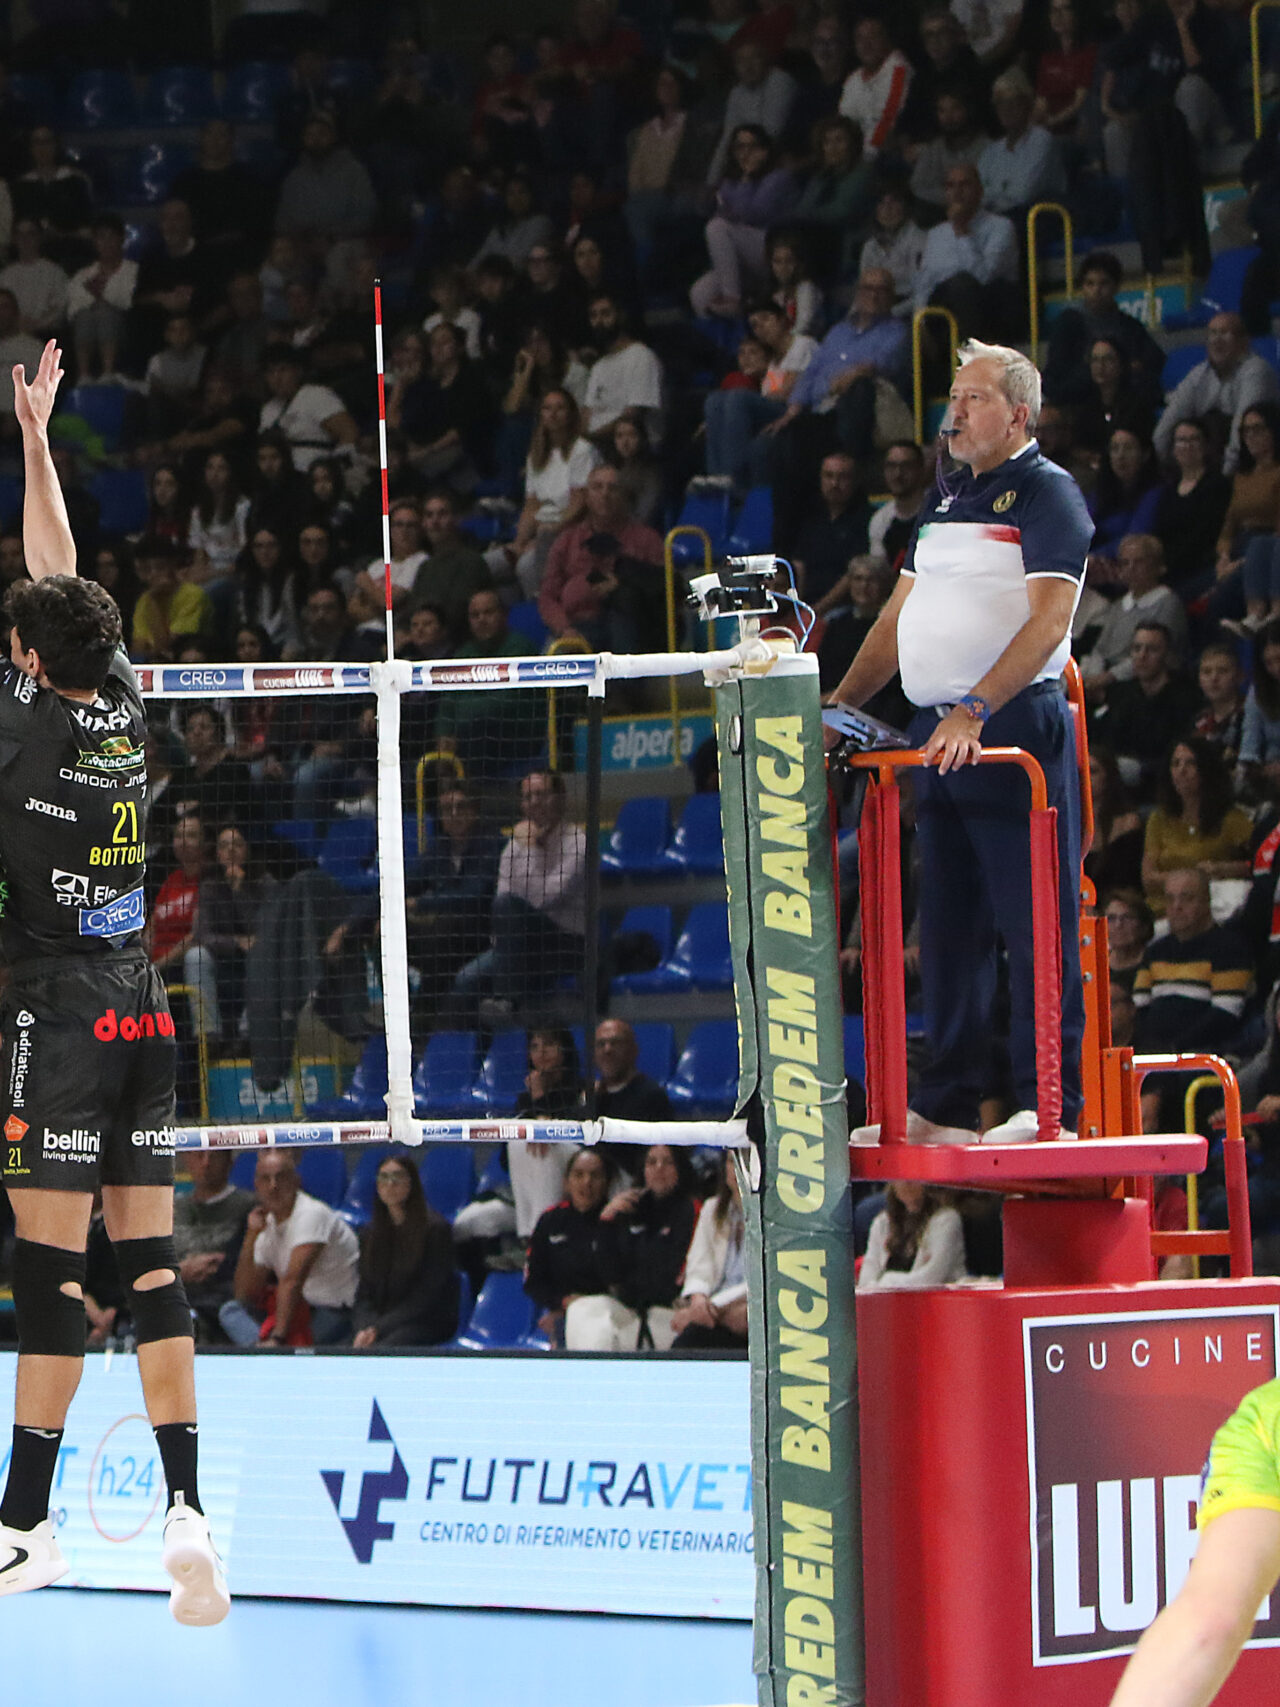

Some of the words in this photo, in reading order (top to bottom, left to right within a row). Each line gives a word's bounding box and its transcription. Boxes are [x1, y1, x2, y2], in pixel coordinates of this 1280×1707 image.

[179, 671, 226, 686] CREO
[295, 669, 326, 687] LUBE
[533, 661, 579, 676] CREO
[612, 722, 694, 770] alpera
[59, 767, 118, 788] OMODA
[112, 801, 138, 844] 21
[754, 716, 813, 938] BANCA
[87, 896, 140, 929] CREO
[13, 1030, 31, 1108] adriaticaoli
[766, 966, 826, 1213] CREDEM
[43, 1127, 100, 1153] bellini
[238, 1131, 260, 1145] LUBE
[287, 1129, 320, 1140] CREO
[499, 1124, 519, 1139] LUBE
[546, 1126, 577, 1137] CREO
[8, 1147, 21, 1167] 21
[42, 1150, 66, 1163] living
[67, 1152, 96, 1164] daylight
[776, 1249, 831, 1472] BANCA
[1045, 1332, 1262, 1373] CUCINE
[97, 1453, 155, 1498] h24
[420, 1521, 488, 1545] CENTRO
[493, 1525, 511, 1546] DI
[517, 1525, 631, 1550] RIFERIMENTO
[637, 1529, 754, 1554] VETERINARIO
[1051, 1474, 1270, 1637] LUB
[782, 1500, 837, 1707] REDEM
